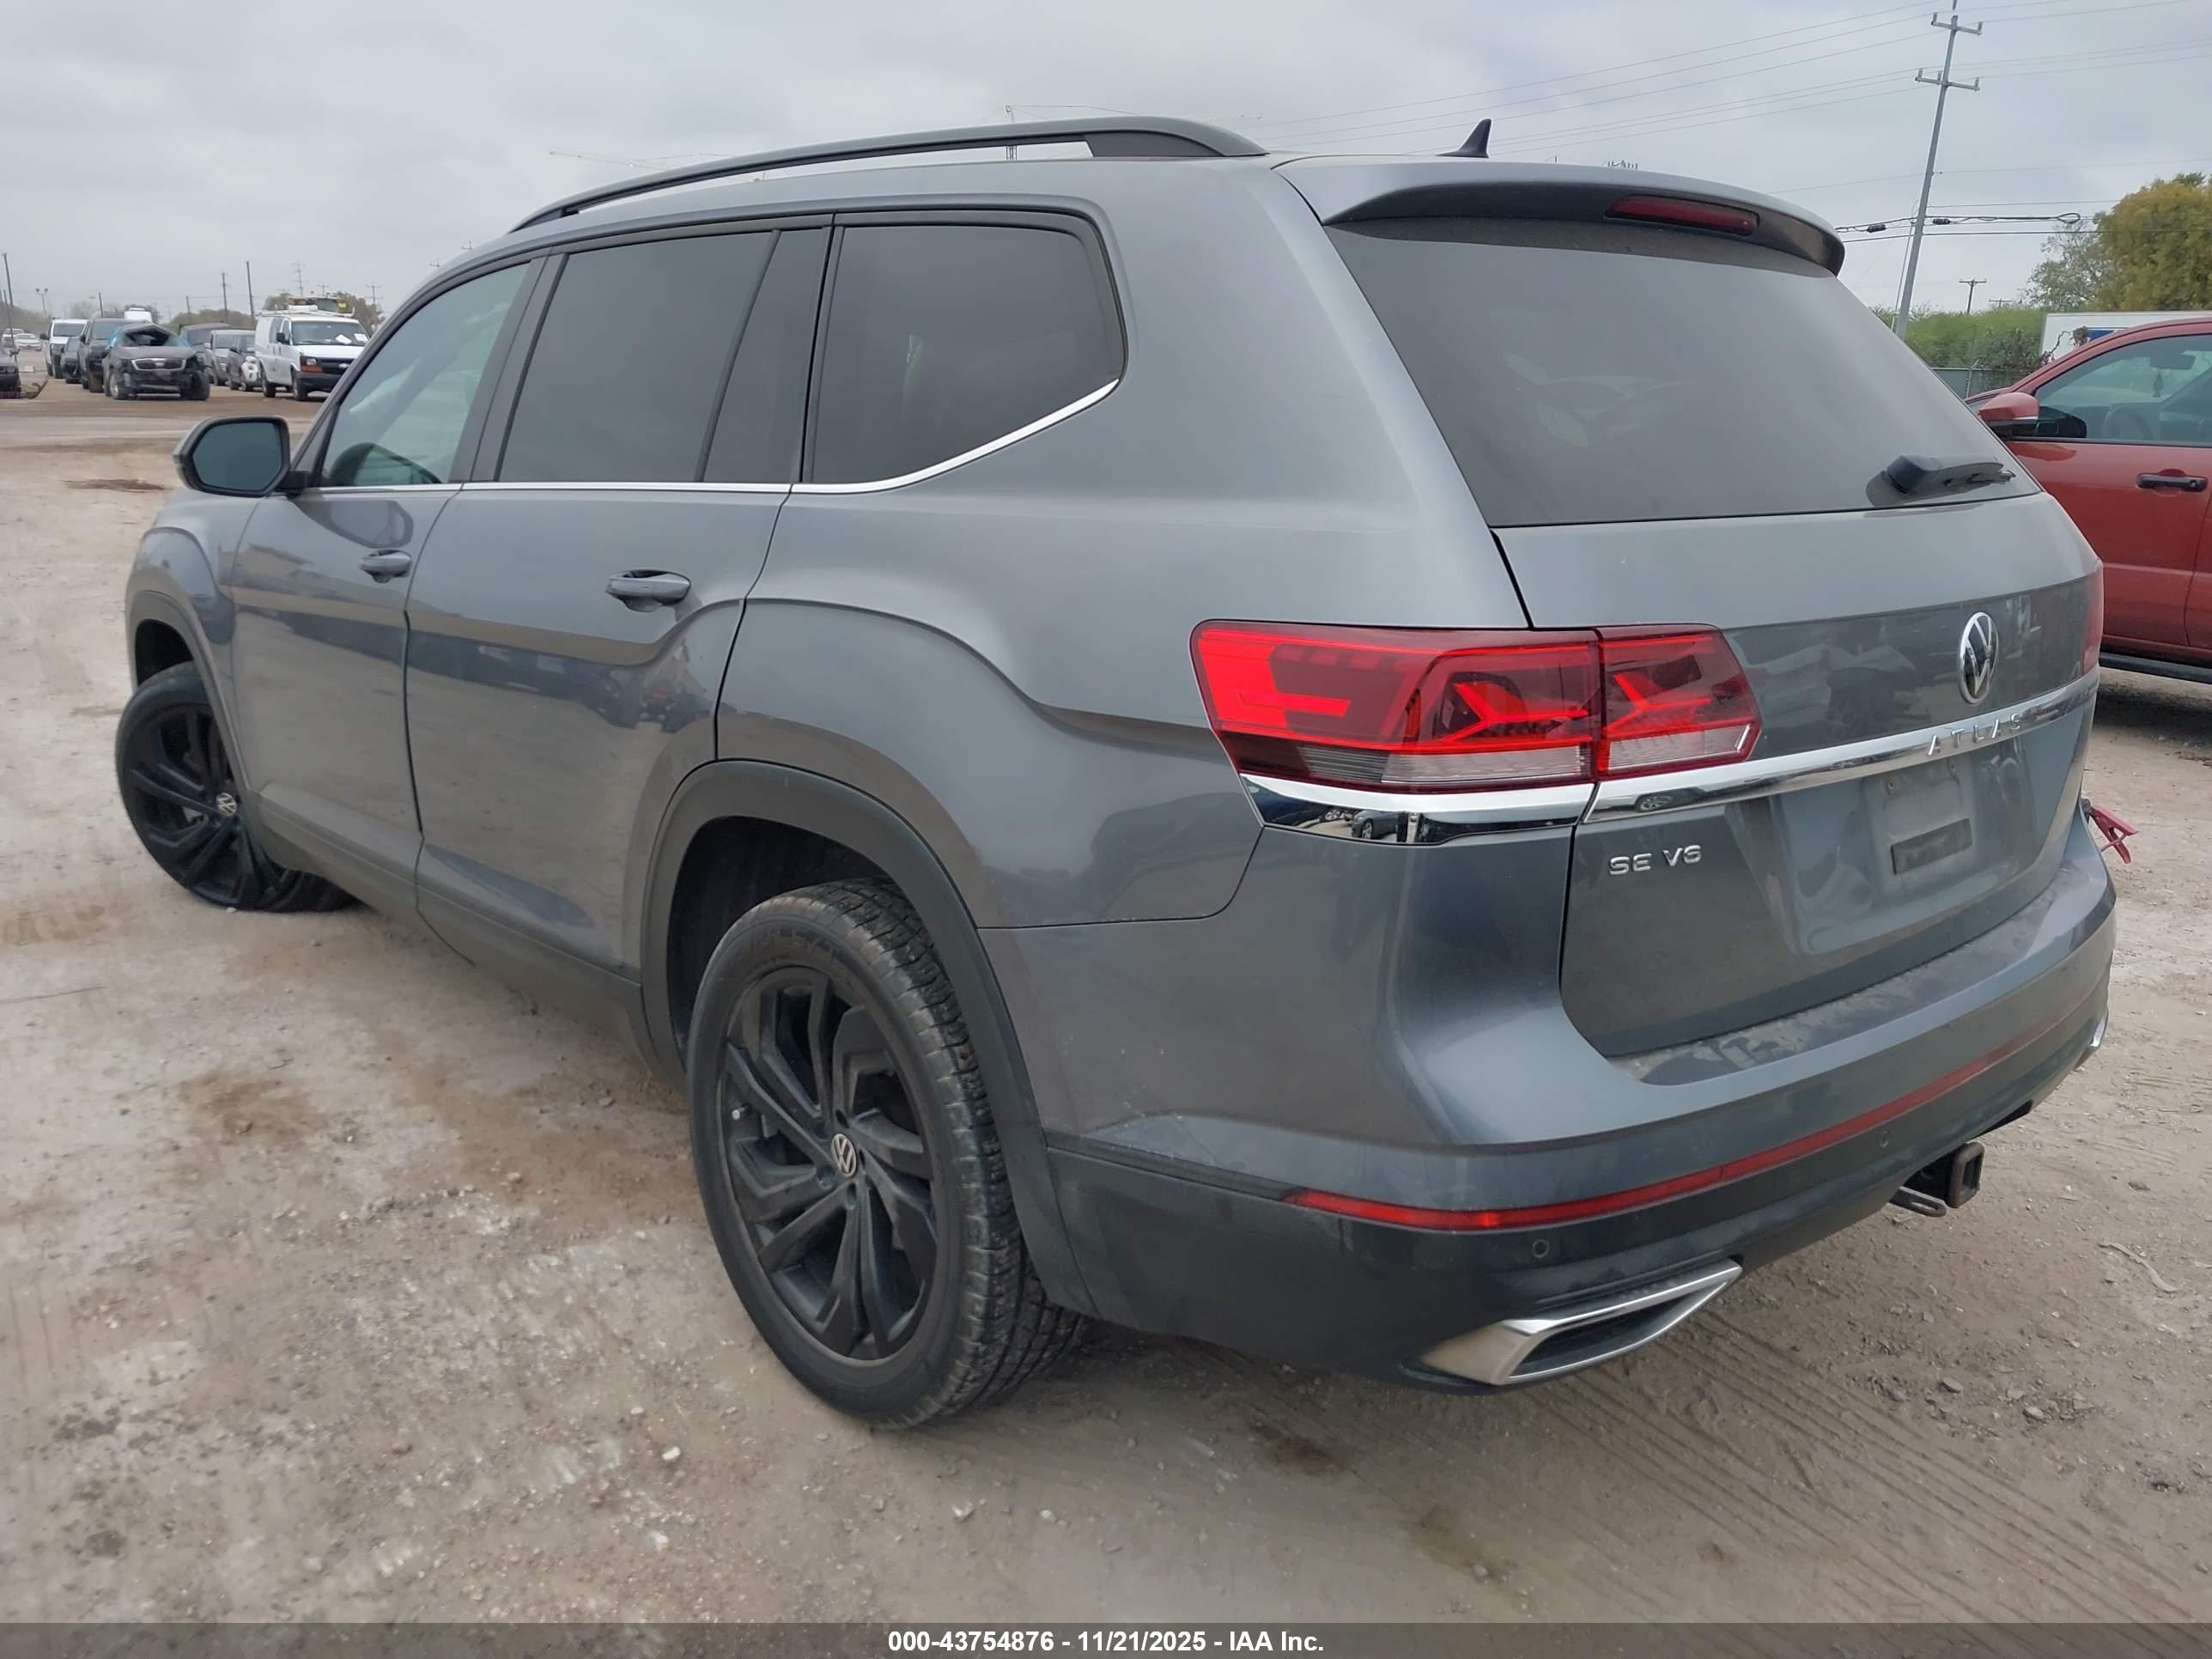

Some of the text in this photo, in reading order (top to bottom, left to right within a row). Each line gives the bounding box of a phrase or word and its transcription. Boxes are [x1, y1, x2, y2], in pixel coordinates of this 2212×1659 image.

[1928, 713, 2021, 757] ATLAS
[1609, 844, 1701, 875] SE V6
